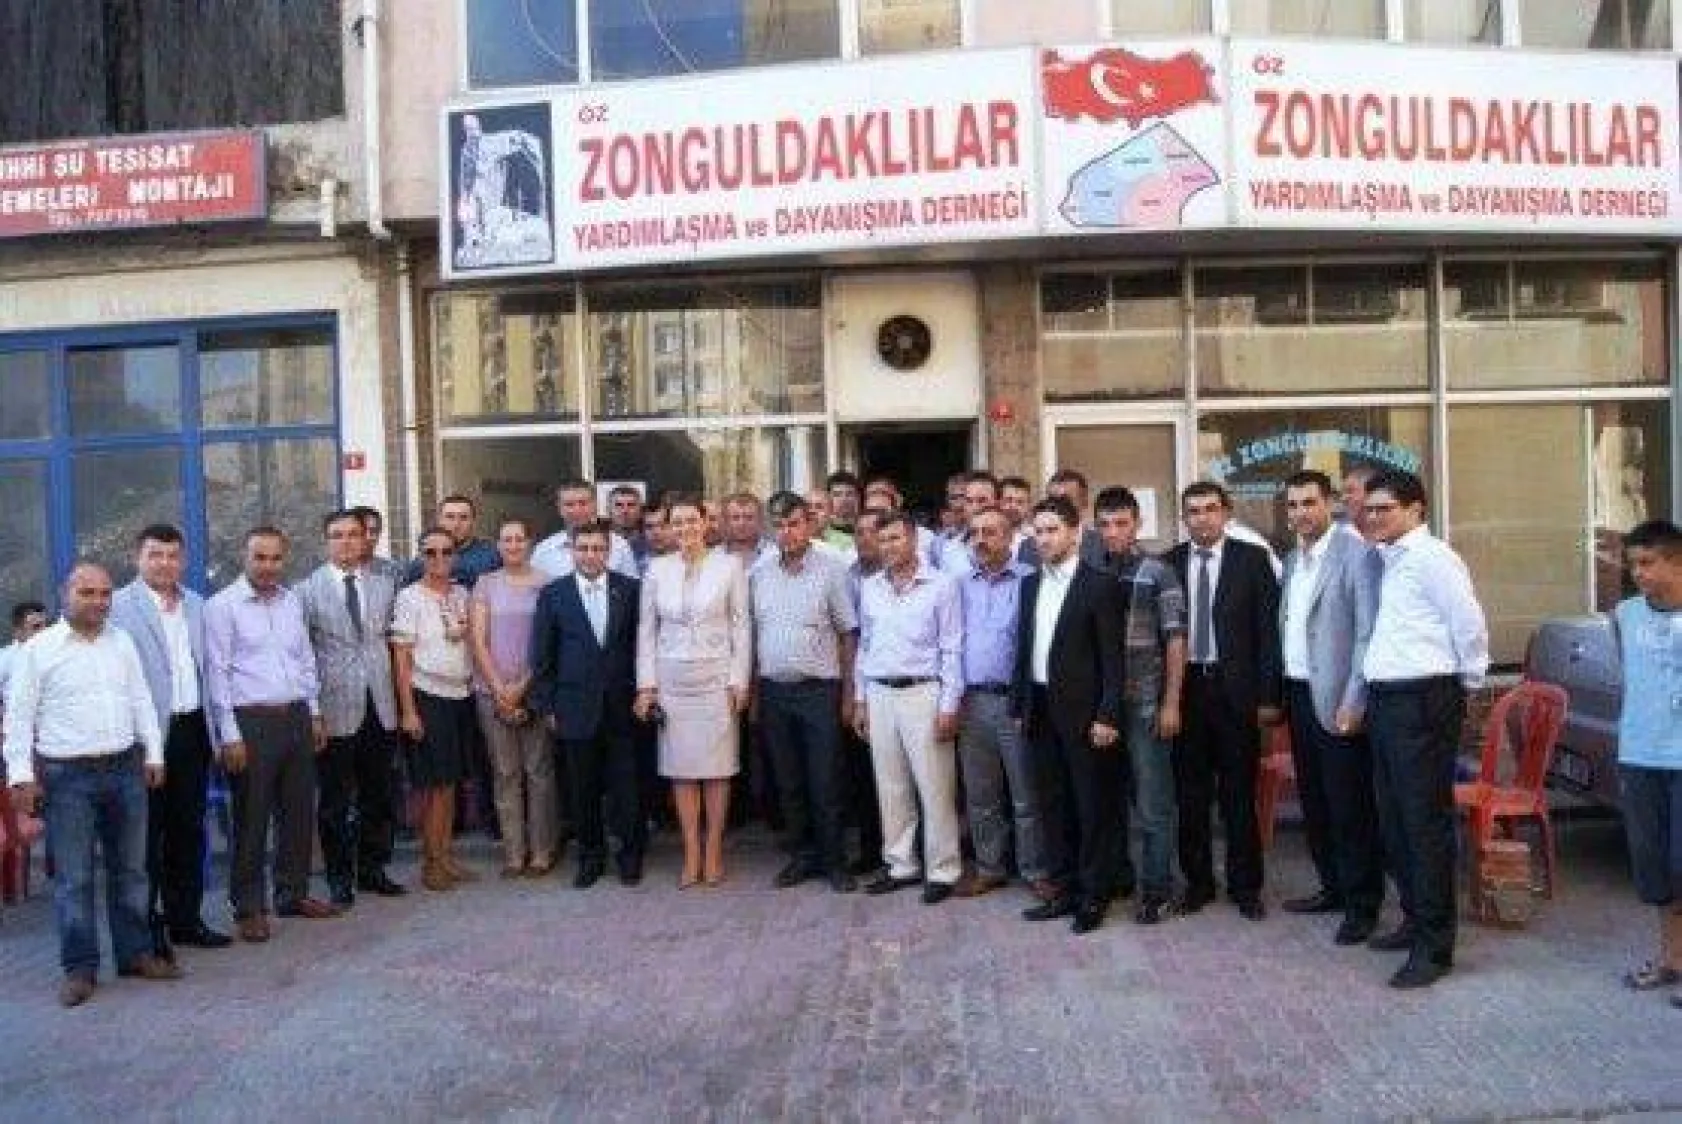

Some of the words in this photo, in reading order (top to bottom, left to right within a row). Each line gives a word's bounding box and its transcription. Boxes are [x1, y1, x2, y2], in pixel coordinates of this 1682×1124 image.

[579, 101, 1019, 202] ZONGULDAKLILAR
[1254, 90, 1661, 167] ZONGULDAKLILAR
[54, 150, 85, 178] SU
[96, 143, 195, 175] TESİSAT
[128, 172, 235, 203] MONTAJI
[572, 212, 738, 252] YARDIMLAŞMA
[745, 218, 768, 238] ve
[775, 198, 916, 237] DAYANIŞMA
[921, 180, 1028, 225] DERNEĞİ
[1251, 182, 1412, 221] YARDIMLAŞMA
[1418, 194, 1441, 213] ve
[1449, 185, 1573, 224] DAYANIŞMA
